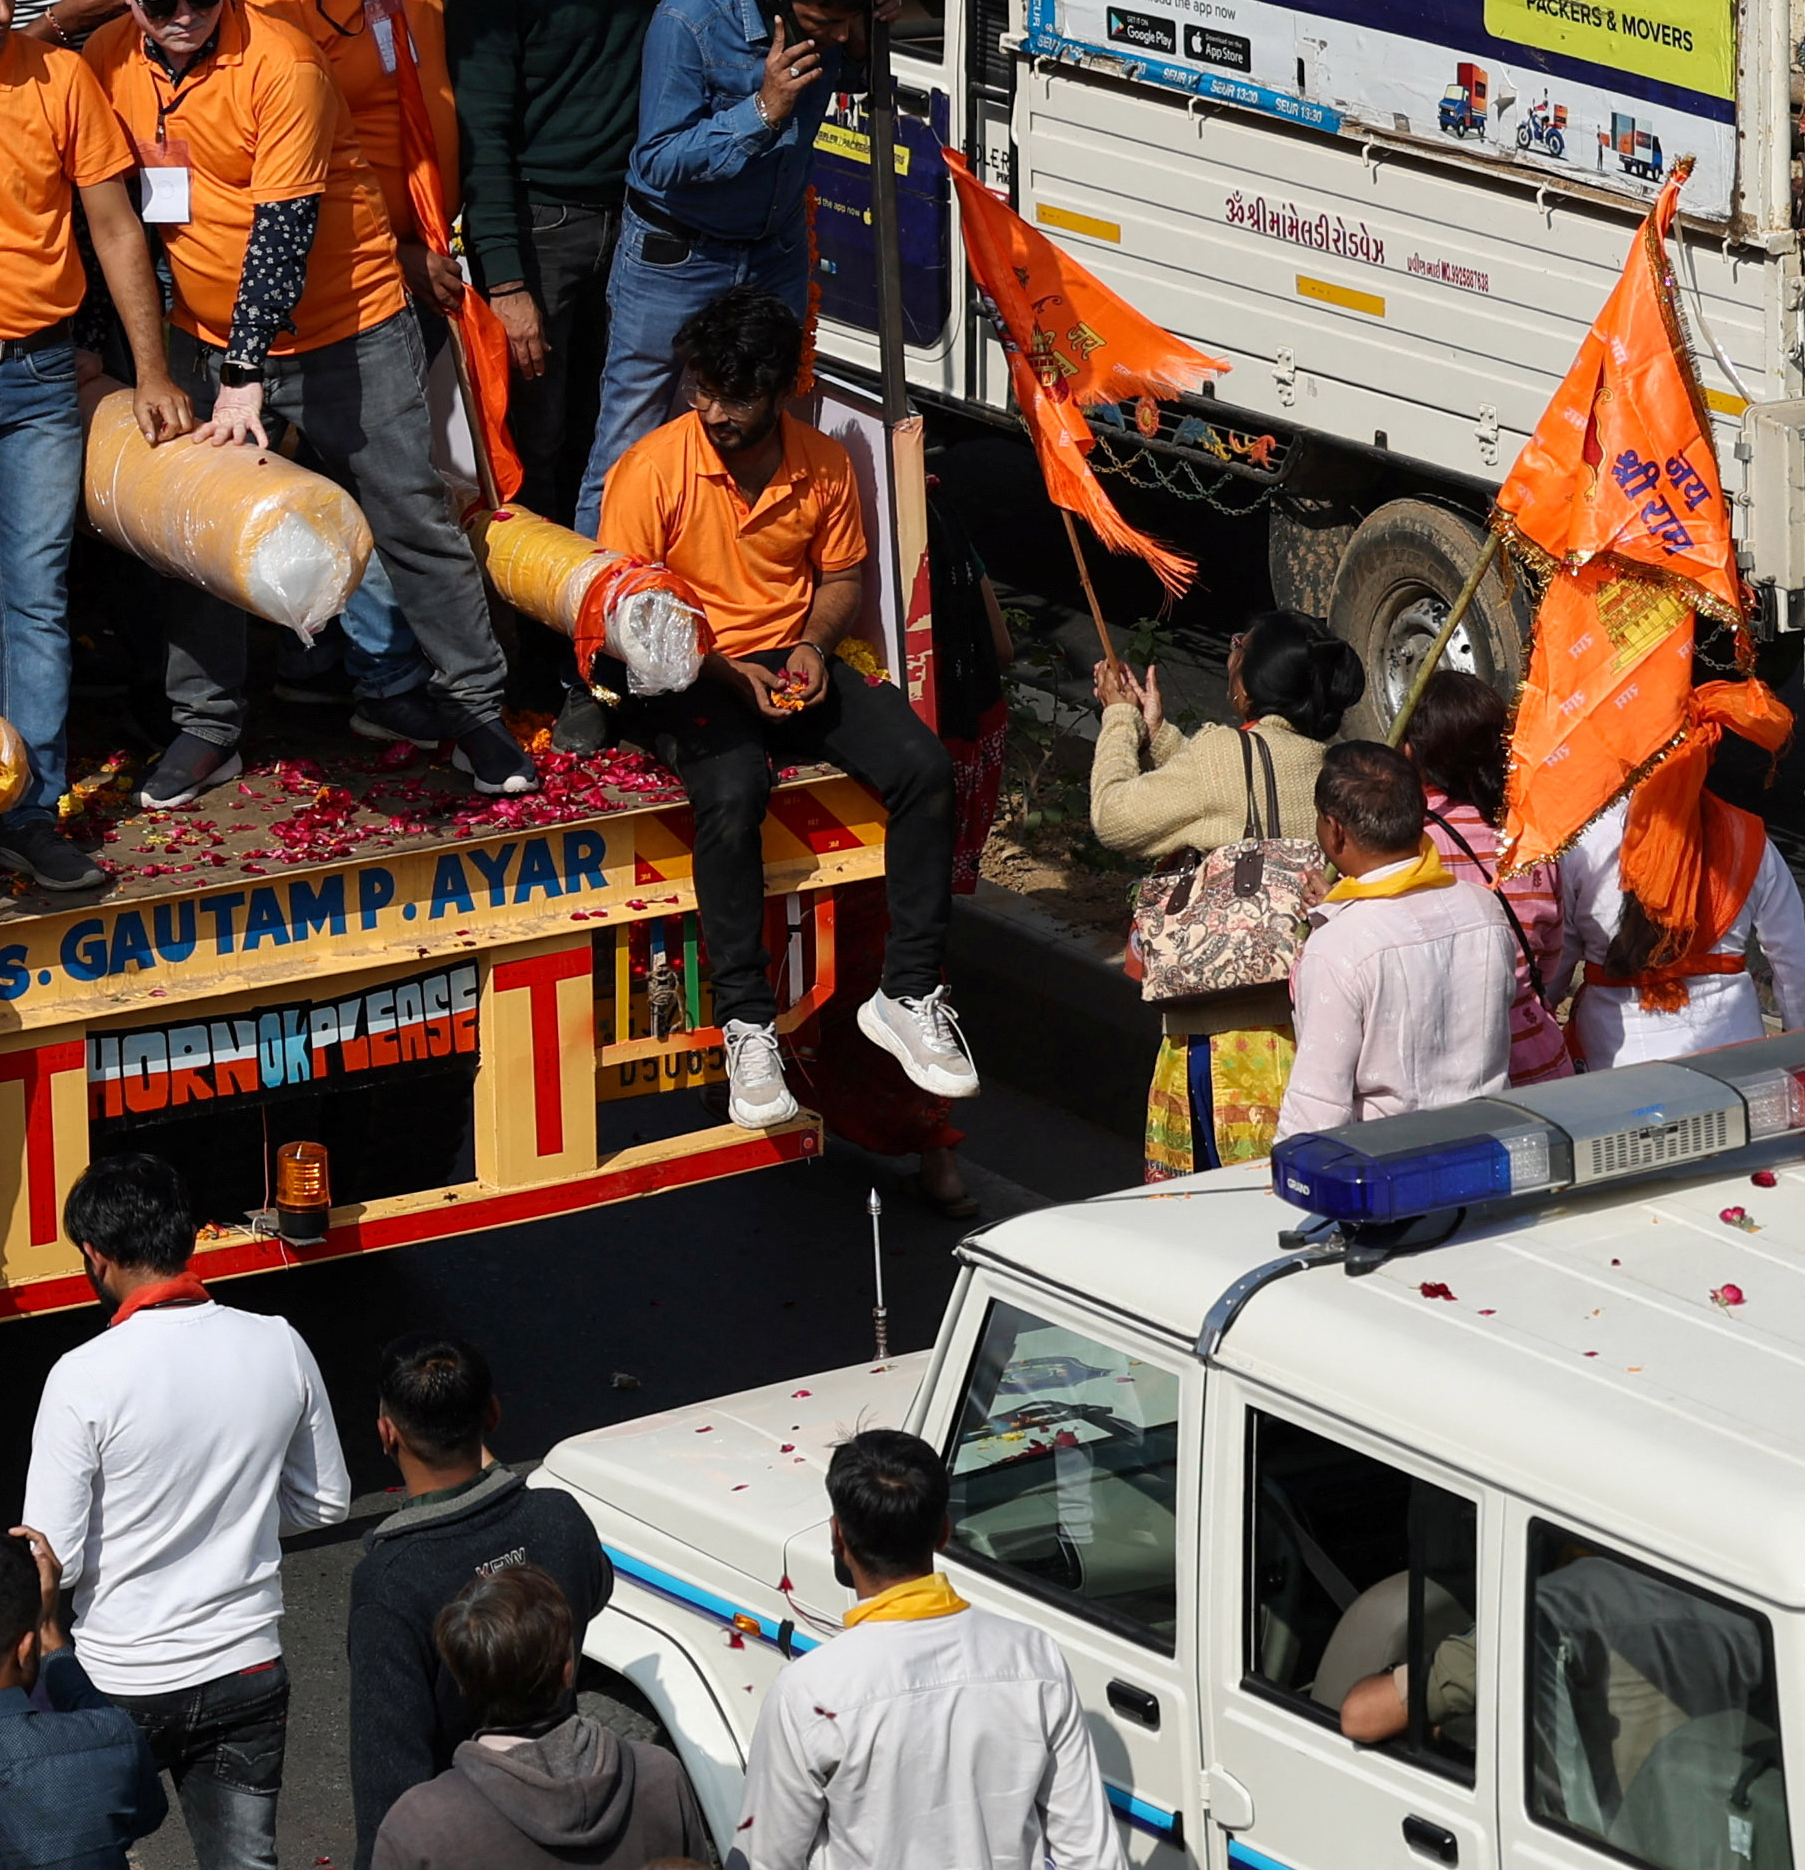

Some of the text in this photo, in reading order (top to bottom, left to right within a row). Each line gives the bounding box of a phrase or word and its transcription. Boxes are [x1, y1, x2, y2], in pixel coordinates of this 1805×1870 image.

[1193, 1, 1212, 18] app
[1215, 6, 1236, 21] now
[1607, 10, 1617, 32] &
[1622, 14, 1694, 52] MOVERS
[1127, 25, 1173, 49] Google Play
[1205, 42, 1243, 64] App Store
[1211, 81, 1322, 123] SEUR SEUR 13:30
[1247, 197, 1267, 233] શ્રી
[1663, 449, 1714, 511] जय
[1611, 449, 1693, 556] श्री राम
[59, 829, 609, 982] GAUTAM P. AYAR
[88, 963, 481, 1120] HORN OK PLEASE
